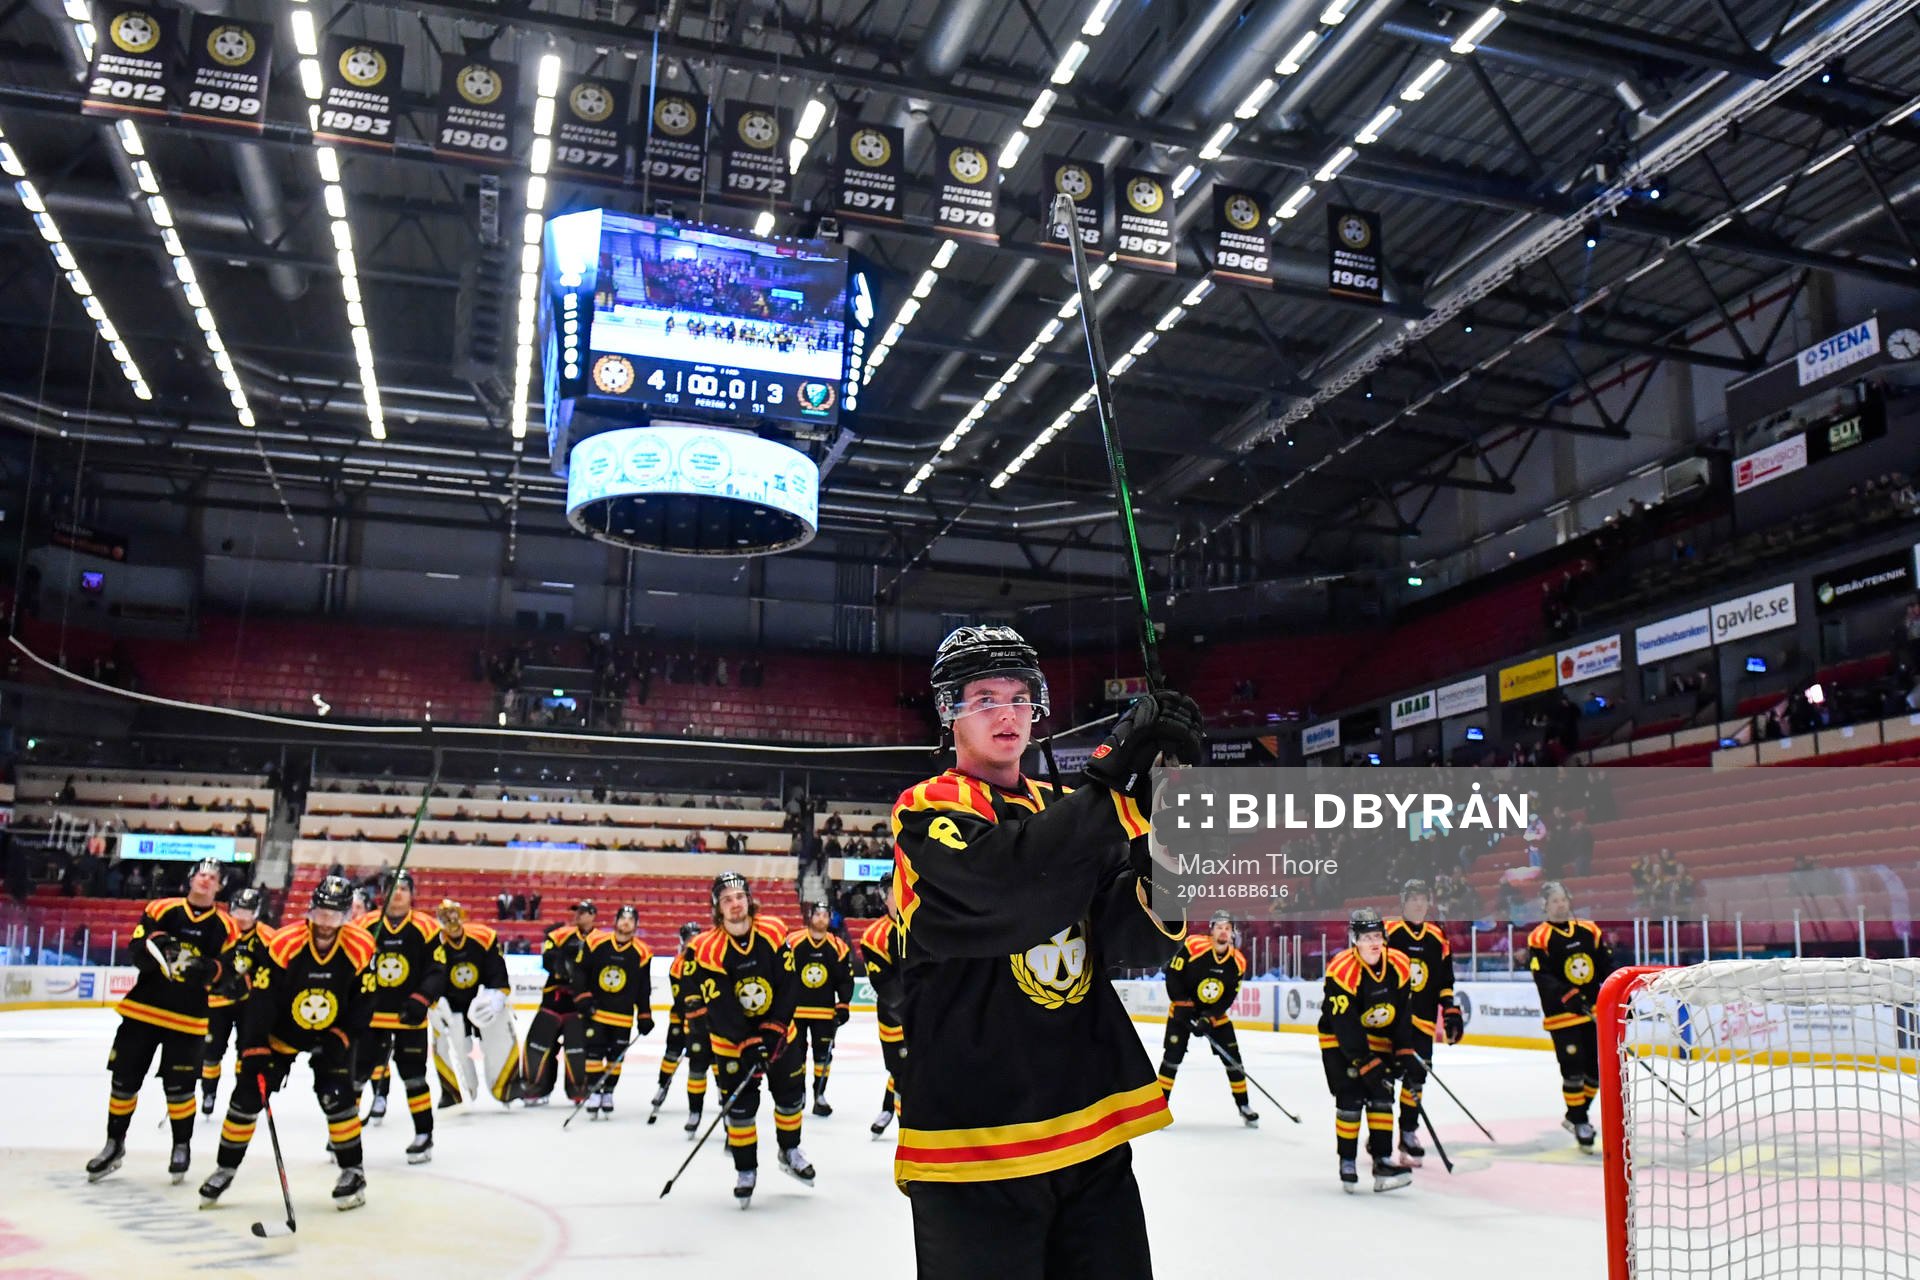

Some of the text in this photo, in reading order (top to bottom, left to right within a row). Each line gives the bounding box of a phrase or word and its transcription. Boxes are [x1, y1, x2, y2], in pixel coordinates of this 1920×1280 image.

[99, 54, 162, 69] SVENSKA
[98, 63, 162, 79] MÄSTARE
[197, 68, 258, 84] SVENSKA
[90, 78, 165, 102] 2012
[195, 76, 258, 93] MÄSTARE
[188, 91, 260, 115] 1999
[327, 95, 390, 113] MÄSTARE
[329, 87, 390, 103] SVENSKA
[448, 106, 505, 120] SVENSKA
[321, 111, 390, 135] 1993
[441, 128, 508, 152] 1980
[556, 145, 618, 168] 1977
[640, 160, 702, 182] 1976
[845, 168, 895, 182] SVENSKA
[728, 172, 786, 194] 1972
[943, 184, 992, 200] SVENSKA
[842, 189, 896, 211] 1971
[942, 192, 992, 208] MÄSTARE
[938, 205, 996, 226] 1970
[1121, 214, 1168, 230] SVENSKA
[1120, 222, 1169, 237] MÄSTARE
[1220, 230, 1264, 244] SVENSKA
[1118, 234, 1172, 255] 1967
[1219, 238, 1266, 252] MÄSTARE
[1217, 250, 1268, 272] 1966
[1332, 270, 1378, 291] 1964
[1820, 325, 1871, 361] STENA
[647, 369, 666, 390] 4
[767, 383, 783, 404] 3
[695, 398, 726, 409] PERIOD
[1716, 598, 1790, 636] gavle.se
[1053, 754, 1088, 763] Carava
